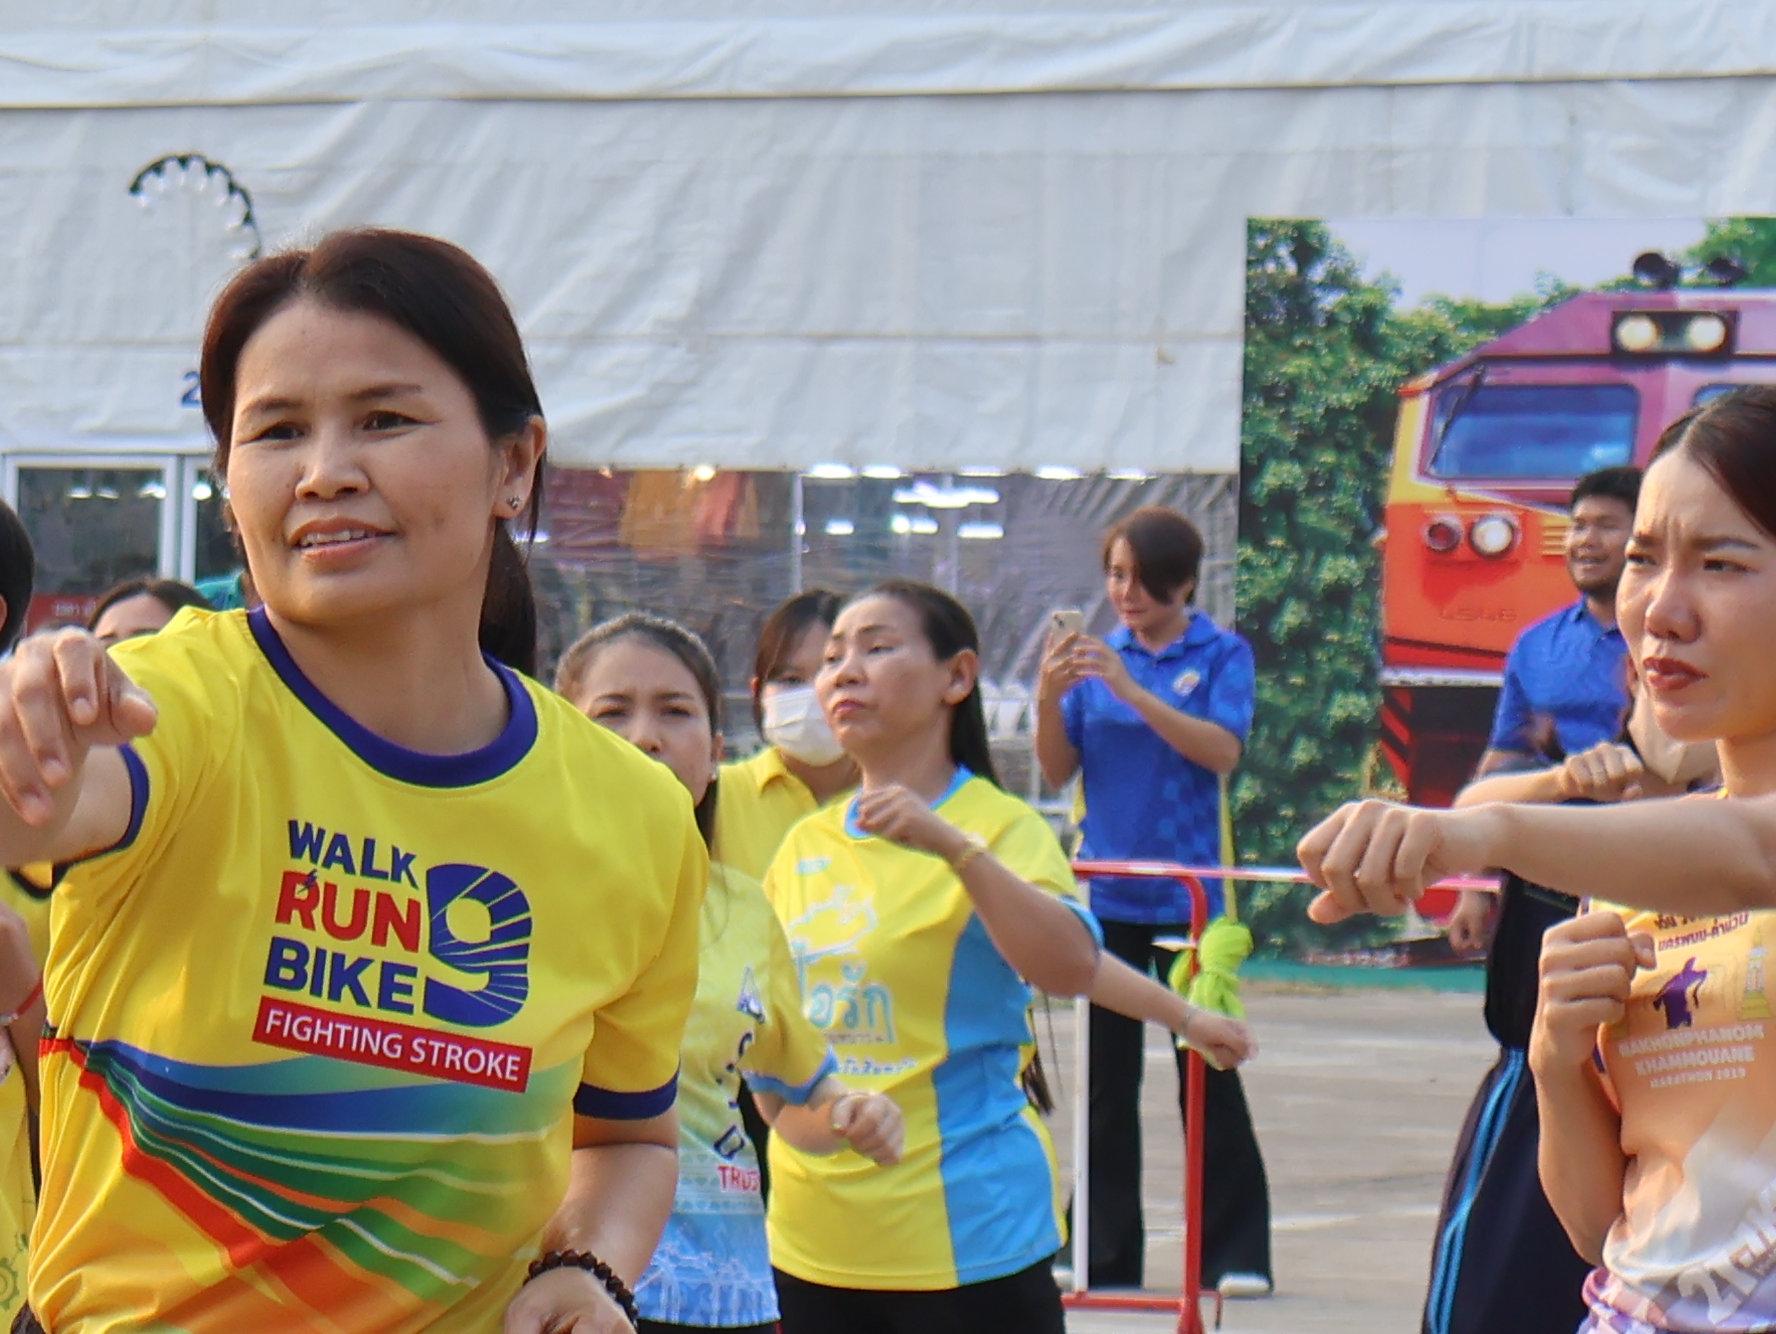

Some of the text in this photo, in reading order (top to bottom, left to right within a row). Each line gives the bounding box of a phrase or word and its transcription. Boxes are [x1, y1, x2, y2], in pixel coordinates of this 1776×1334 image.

[287, 819, 420, 890] WALK
[275, 870, 421, 953] RUN
[263, 936, 419, 1016] BIKE
[265, 1009, 521, 1082] FIGHTING STROKE
[1635, 1045, 1755, 1076] KHAMMOUANE
